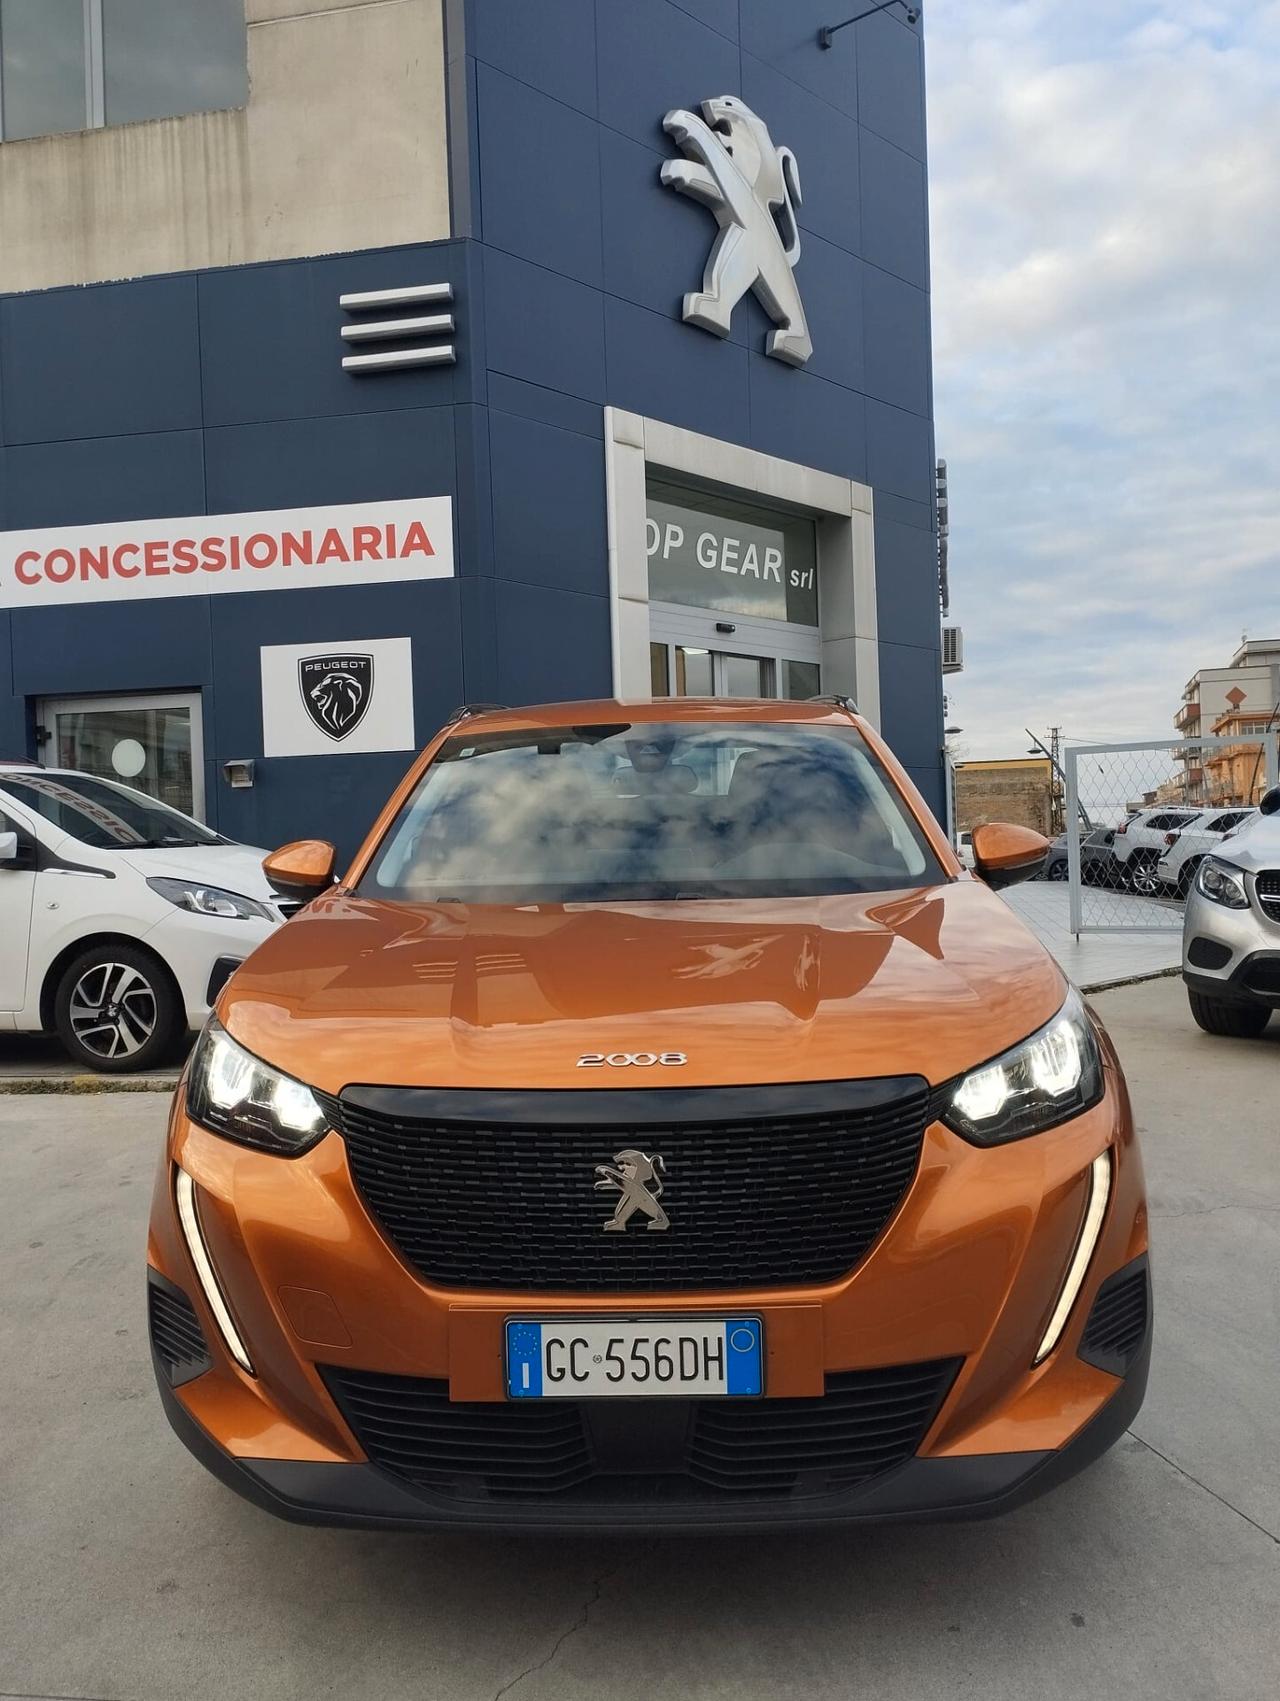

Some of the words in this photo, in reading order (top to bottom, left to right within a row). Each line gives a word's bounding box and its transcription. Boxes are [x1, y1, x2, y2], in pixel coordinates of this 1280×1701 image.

[14, 521, 435, 585] CONCESSIONARIA
[696, 532, 782, 583] GEAR
[790, 568, 814, 590] srl
[305, 661, 367, 672] PEUGEOT
[576, 1052, 688, 1067] 2008
